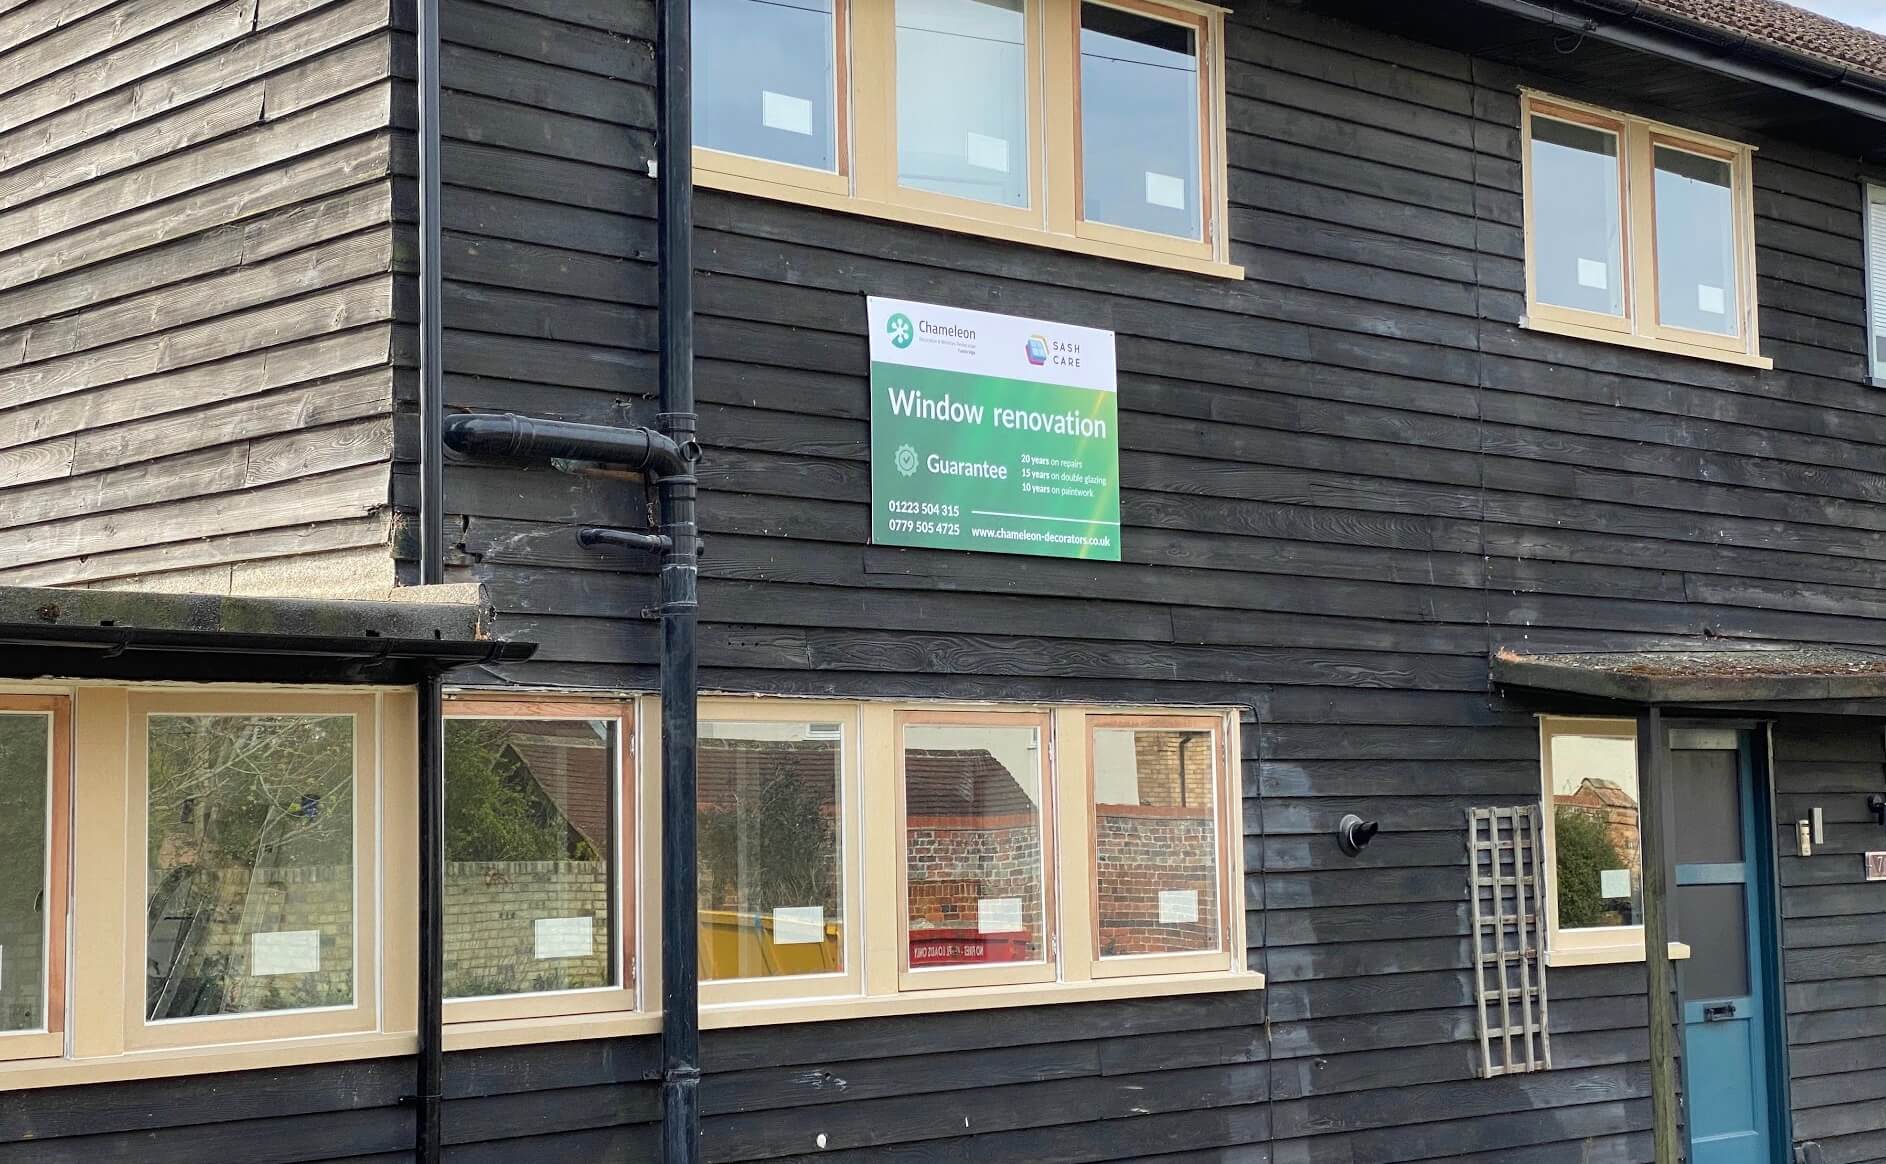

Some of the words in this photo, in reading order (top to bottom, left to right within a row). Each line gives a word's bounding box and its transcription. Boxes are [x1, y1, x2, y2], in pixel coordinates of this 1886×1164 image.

[919, 320, 976, 340] Chameleon
[1053, 341, 1080, 353] SASH
[1053, 355, 1080, 367] CARE
[888, 387, 984, 425] Window
[993, 407, 1106, 438] renovation
[927, 454, 1007, 479] Guarantee
[1021, 454, 1031, 463] 20
[1031, 456, 1049, 466] years
[1050, 458, 1059, 466] on
[1060, 458, 1082, 468] repairs
[1022, 468, 1031, 477] 15
[1031, 471, 1050, 480] years
[1060, 473, 1083, 483] double
[1084, 475, 1107, 486] glazing
[1022, 483, 1031, 491] 10
[1031, 485, 1050, 494] years
[1061, 487, 1094, 497] paintwork
[888, 500, 919, 514] 01223
[921, 503, 939, 515] 504
[941, 504, 960, 517] 315
[889, 519, 914, 532] 0779
[916, 521, 934, 533] 505
[936, 523, 960, 536] 4725
[971, 527, 1110, 547] www.chameleon-decorators.co.uk
